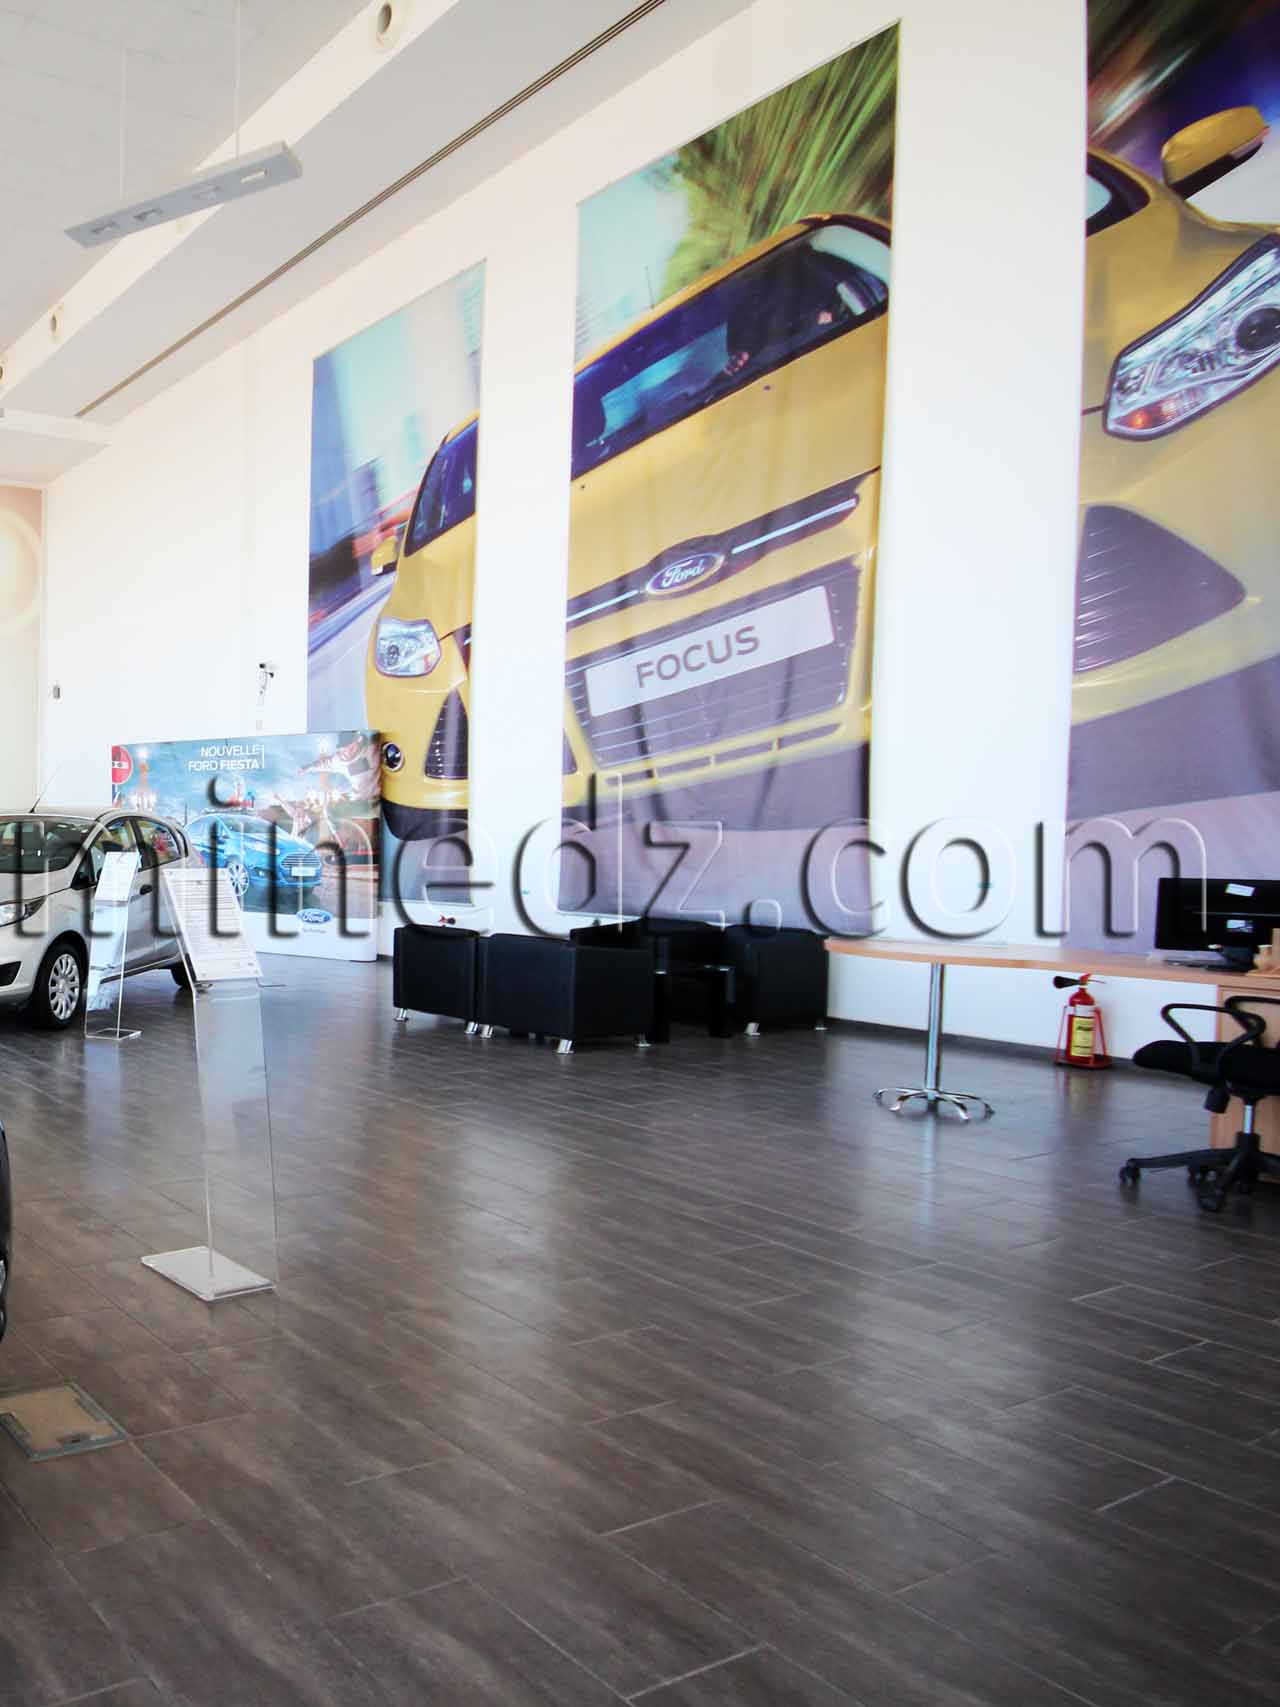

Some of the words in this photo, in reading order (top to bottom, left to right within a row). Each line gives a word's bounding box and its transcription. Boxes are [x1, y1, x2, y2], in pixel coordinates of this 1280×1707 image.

[661, 559, 705, 588] Ford
[636, 626, 760, 689] FOCUS
[200, 744, 260, 758] NOUVELLE
[187, 759, 218, 773] FORD
[220, 758, 260, 771] FIESTA
